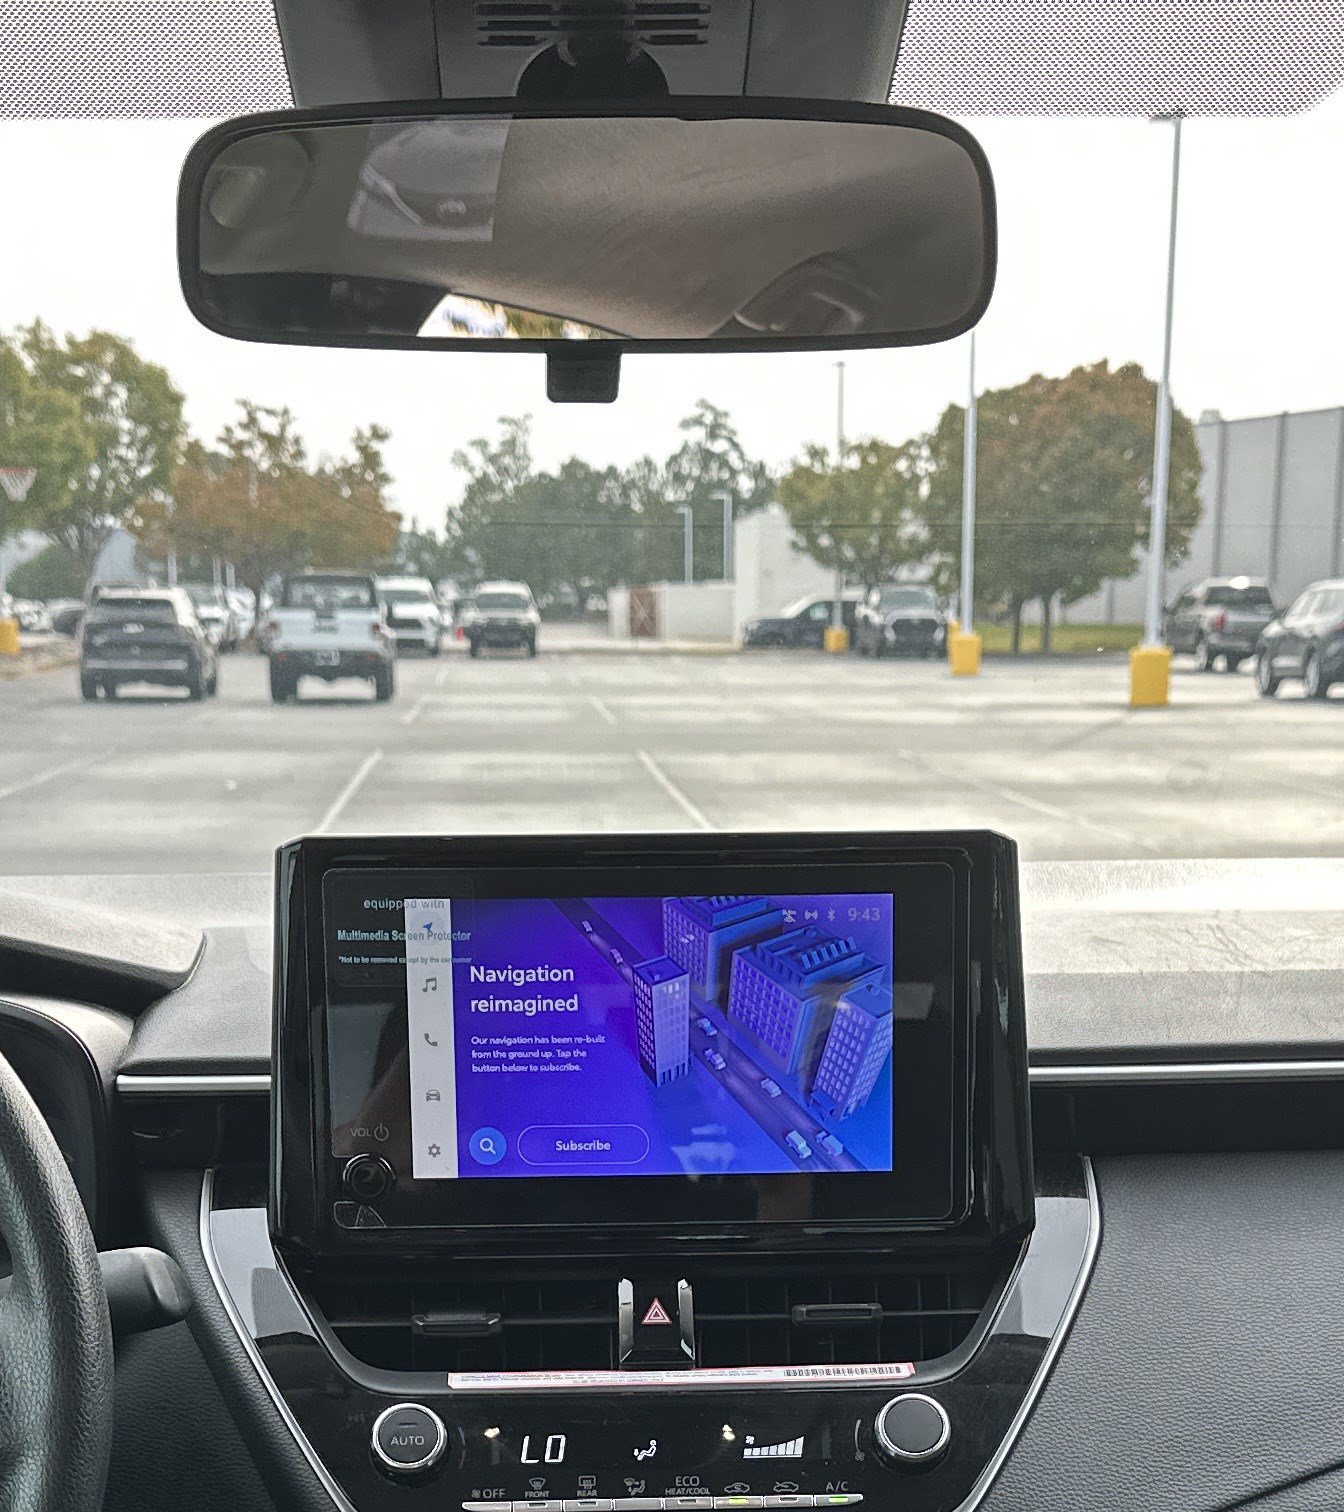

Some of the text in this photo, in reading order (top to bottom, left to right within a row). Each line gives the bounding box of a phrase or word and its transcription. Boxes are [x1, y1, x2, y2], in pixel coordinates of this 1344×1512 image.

[363, 897, 445, 911] equipped with
[847, 907, 881, 921] 9:43
[337, 930, 472, 942] Multimedia Screen Protector
[470, 965, 575, 987] Navigation
[471, 993, 579, 1017] reimagined
[471, 1034, 606, 1047] Our navigation has been re-built
[471, 1048, 587, 1060] from the ground up. Tap the
[471, 1062, 582, 1073] button below to subscribe.
[349, 1127, 372, 1137] VOL
[555, 1140, 612, 1152] Subscribe
[389, 1435, 425, 1446] AUTO
[521, 1434, 566, 1463] LO
[675, 1476, 700, 1487] ECO
[825, 1480, 849, 1492] A/C
[482, 1488, 506, 1499] OFF
[525, 1490, 550, 1498] FRONT
[576, 1489, 598, 1497] REAR
[665, 1487, 711, 1495] HEAT/COOL
